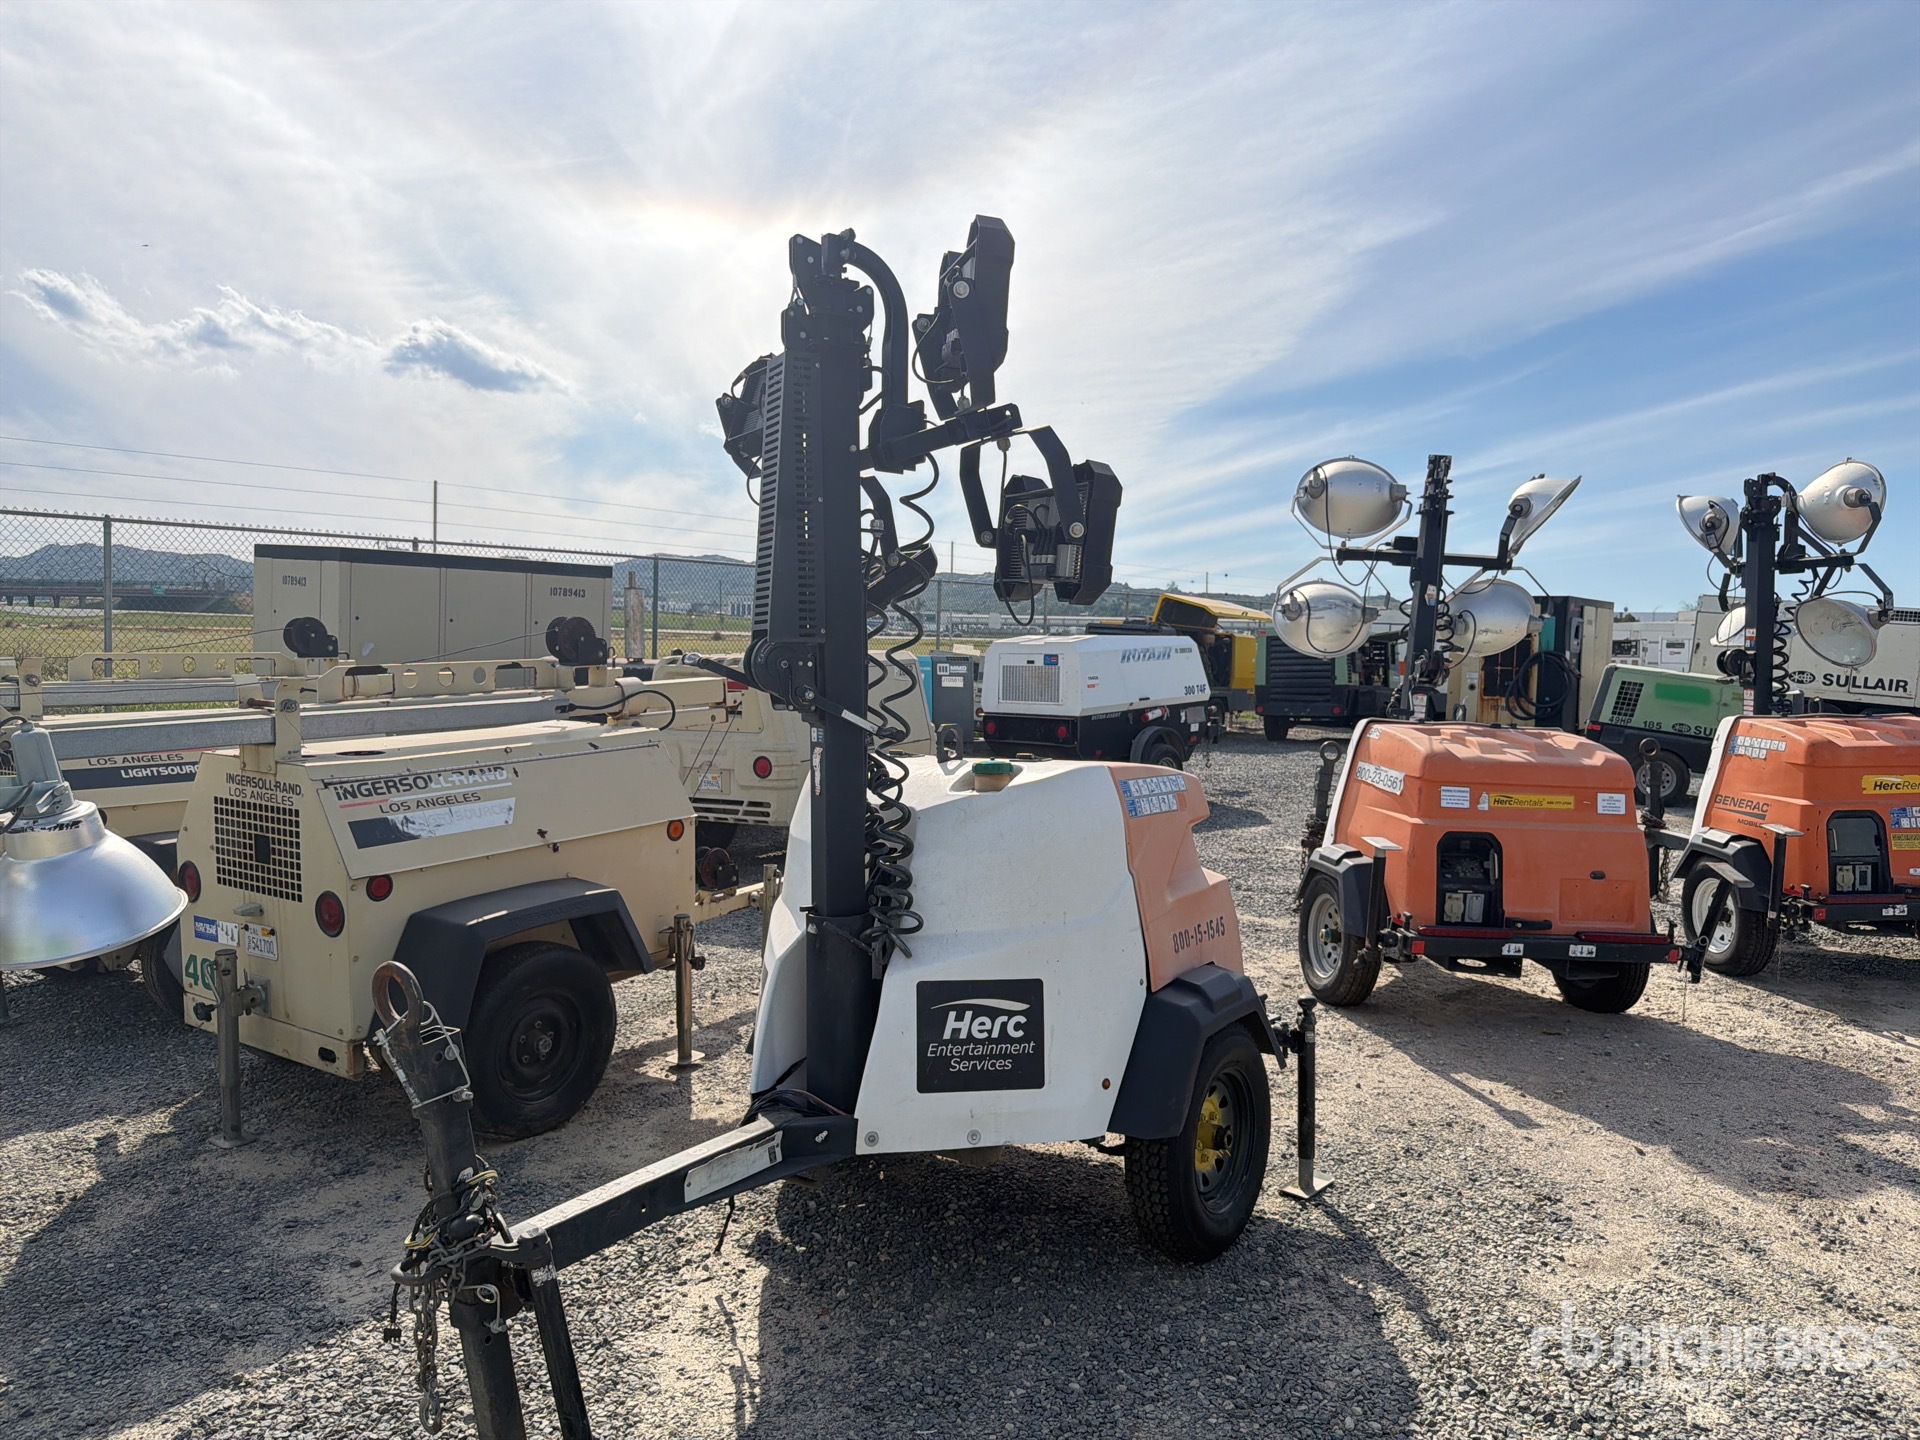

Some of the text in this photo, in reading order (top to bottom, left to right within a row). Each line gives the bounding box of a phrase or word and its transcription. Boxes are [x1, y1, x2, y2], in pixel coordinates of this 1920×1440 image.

[550, 587, 586, 598] 10789413
[1120, 646, 1172, 664] ROTAIR
[1184, 684, 1207, 696] 300 T4F
[1822, 673, 1909, 693] SULLAIR
[1608, 716, 1632, 726] 49HP
[1642, 720, 1662, 730] 185
[88, 753, 184, 766] LOS ANGELES
[335, 766, 508, 801] INGERSOLL-RAND
[1356, 766, 1403, 791] 800-23-0561
[228, 786, 294, 807] LOS ANGELES
[379, 792, 481, 814] LOS ANGELES
[1493, 798, 1542, 807] HercRentals
[1715, 794, 1770, 813] GENERAC
[1172, 915, 1226, 954] 800-15-1545
[252, 936, 274, 955] 541700
[942, 1010, 1027, 1040] Herc
[927, 1041, 1036, 1057] Entertainment
[949, 1057, 1013, 1072] Services
